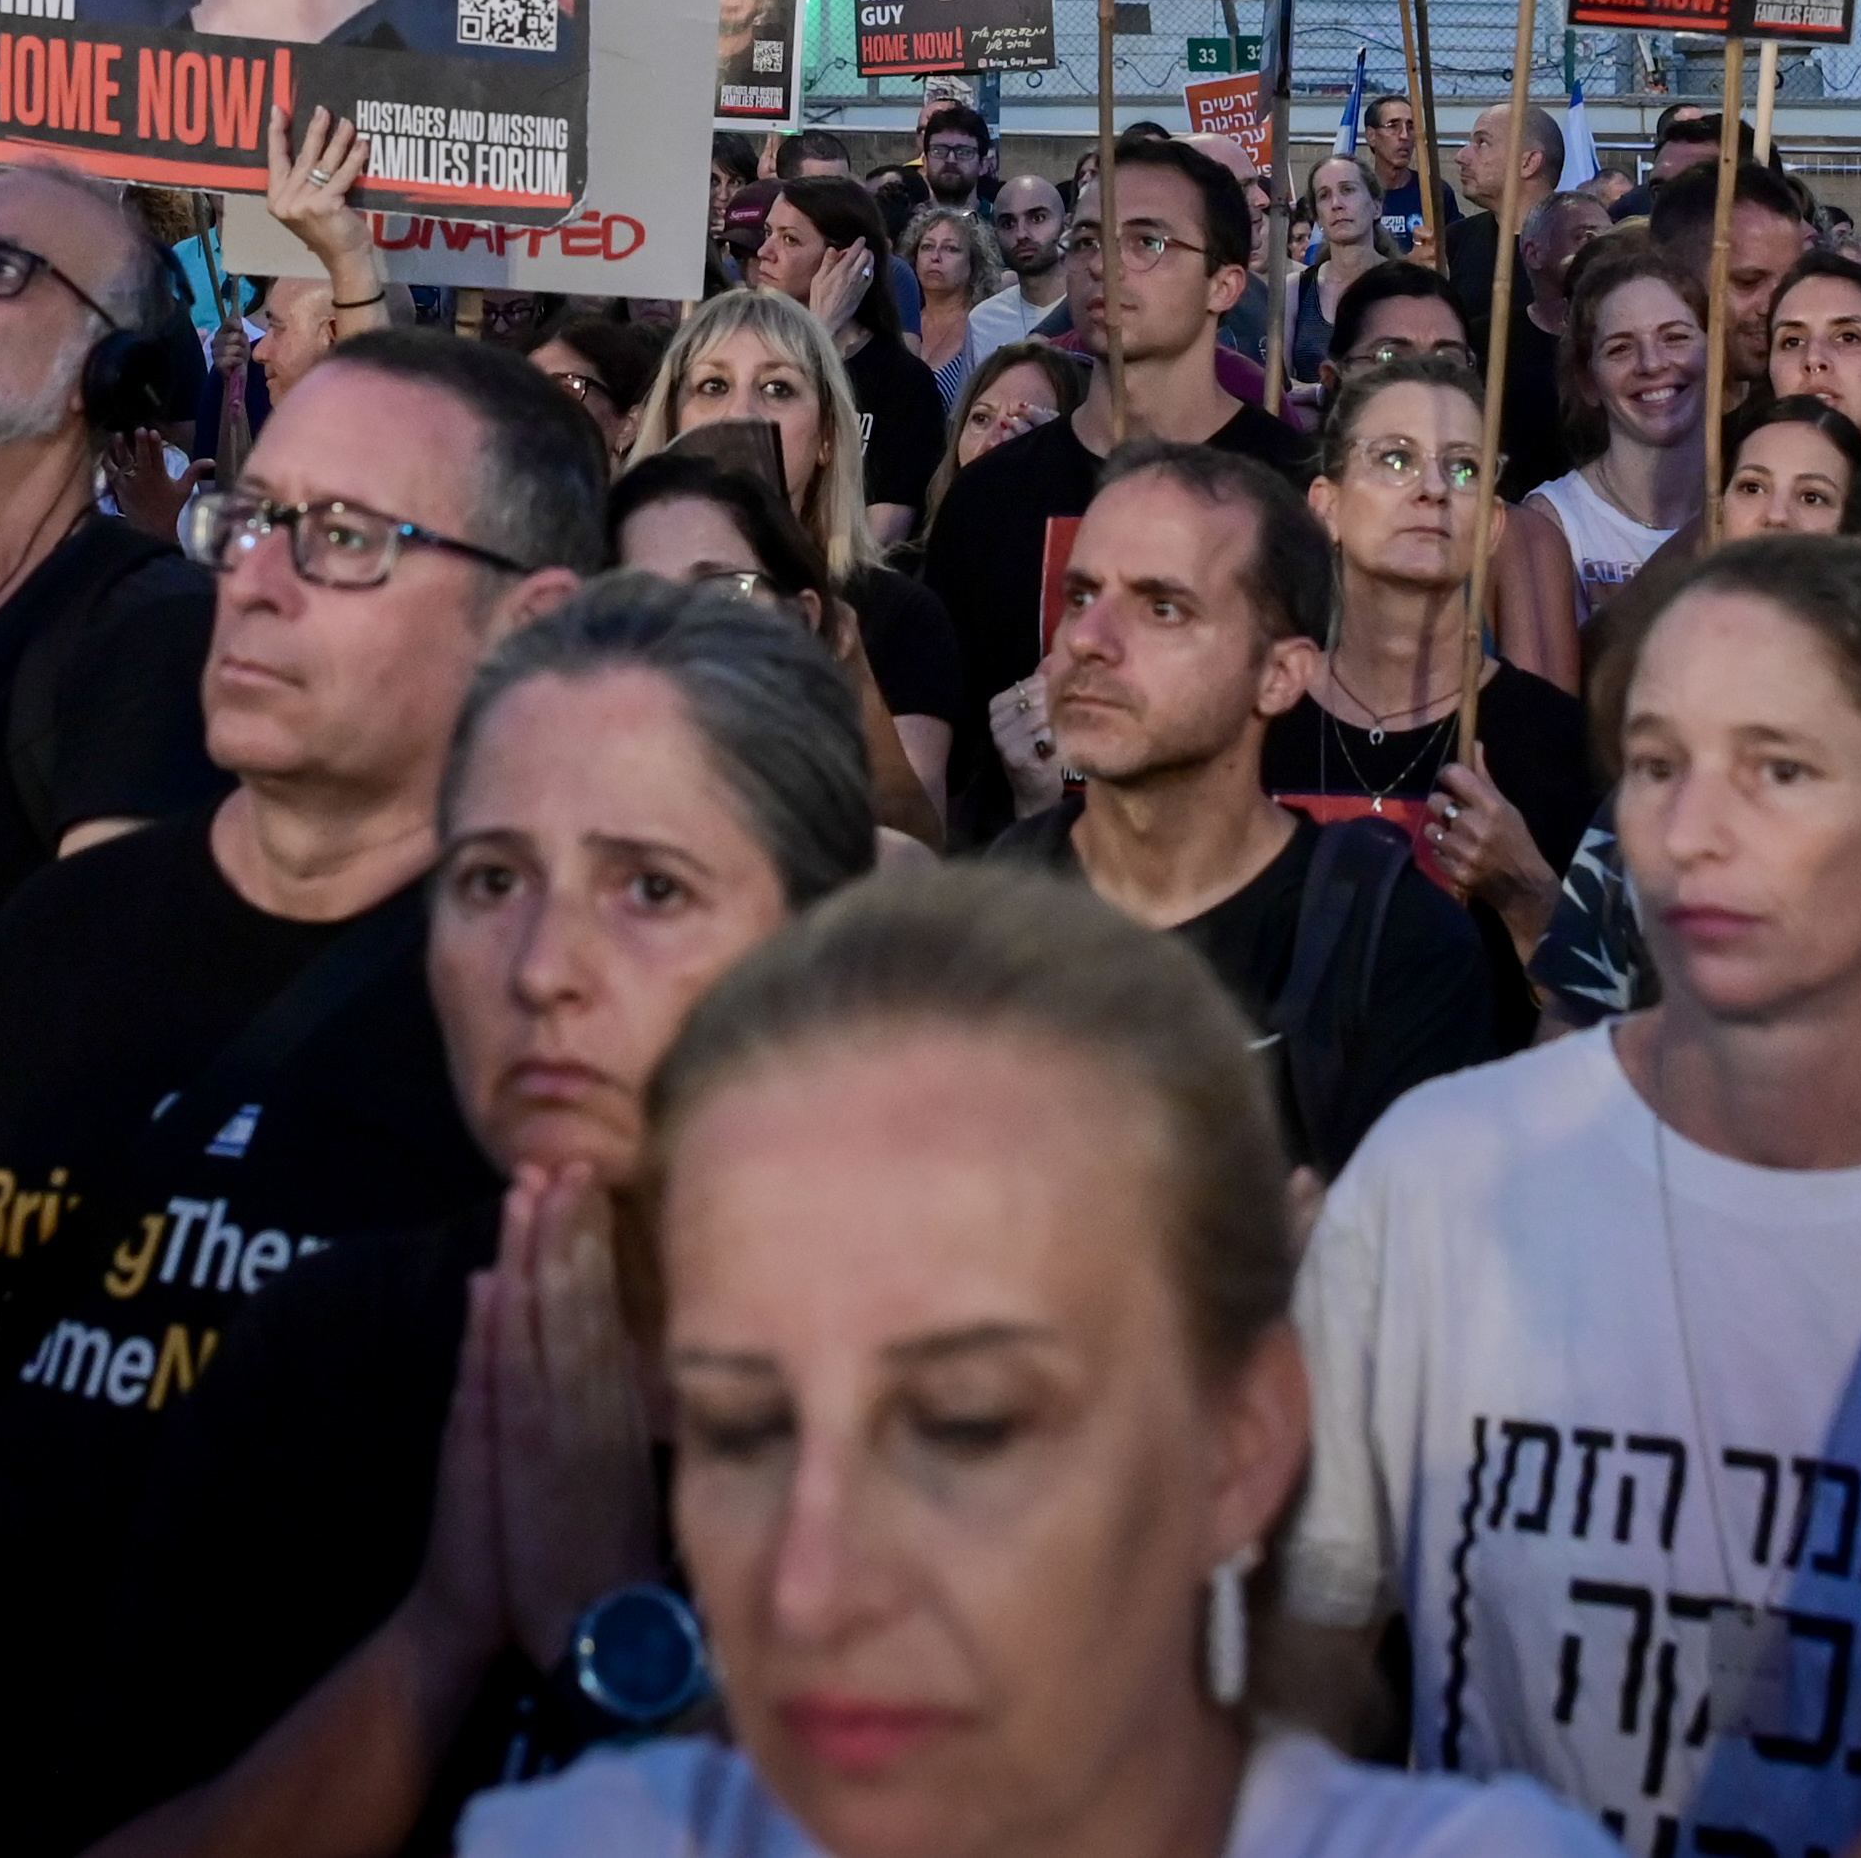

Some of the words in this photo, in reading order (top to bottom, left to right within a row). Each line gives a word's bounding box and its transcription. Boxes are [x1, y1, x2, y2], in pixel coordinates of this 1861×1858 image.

[861, 5, 904, 25] GUY
[862, 34, 909, 63] HOME
[913, 27, 964, 62] NOW!
[1198, 48, 1217, 64] 33
[357, 100, 445, 137] HOSTAGES
[448, 109, 485, 143] AND
[489, 113, 568, 150] MISSING
[476, 143, 567, 197] FORUM
